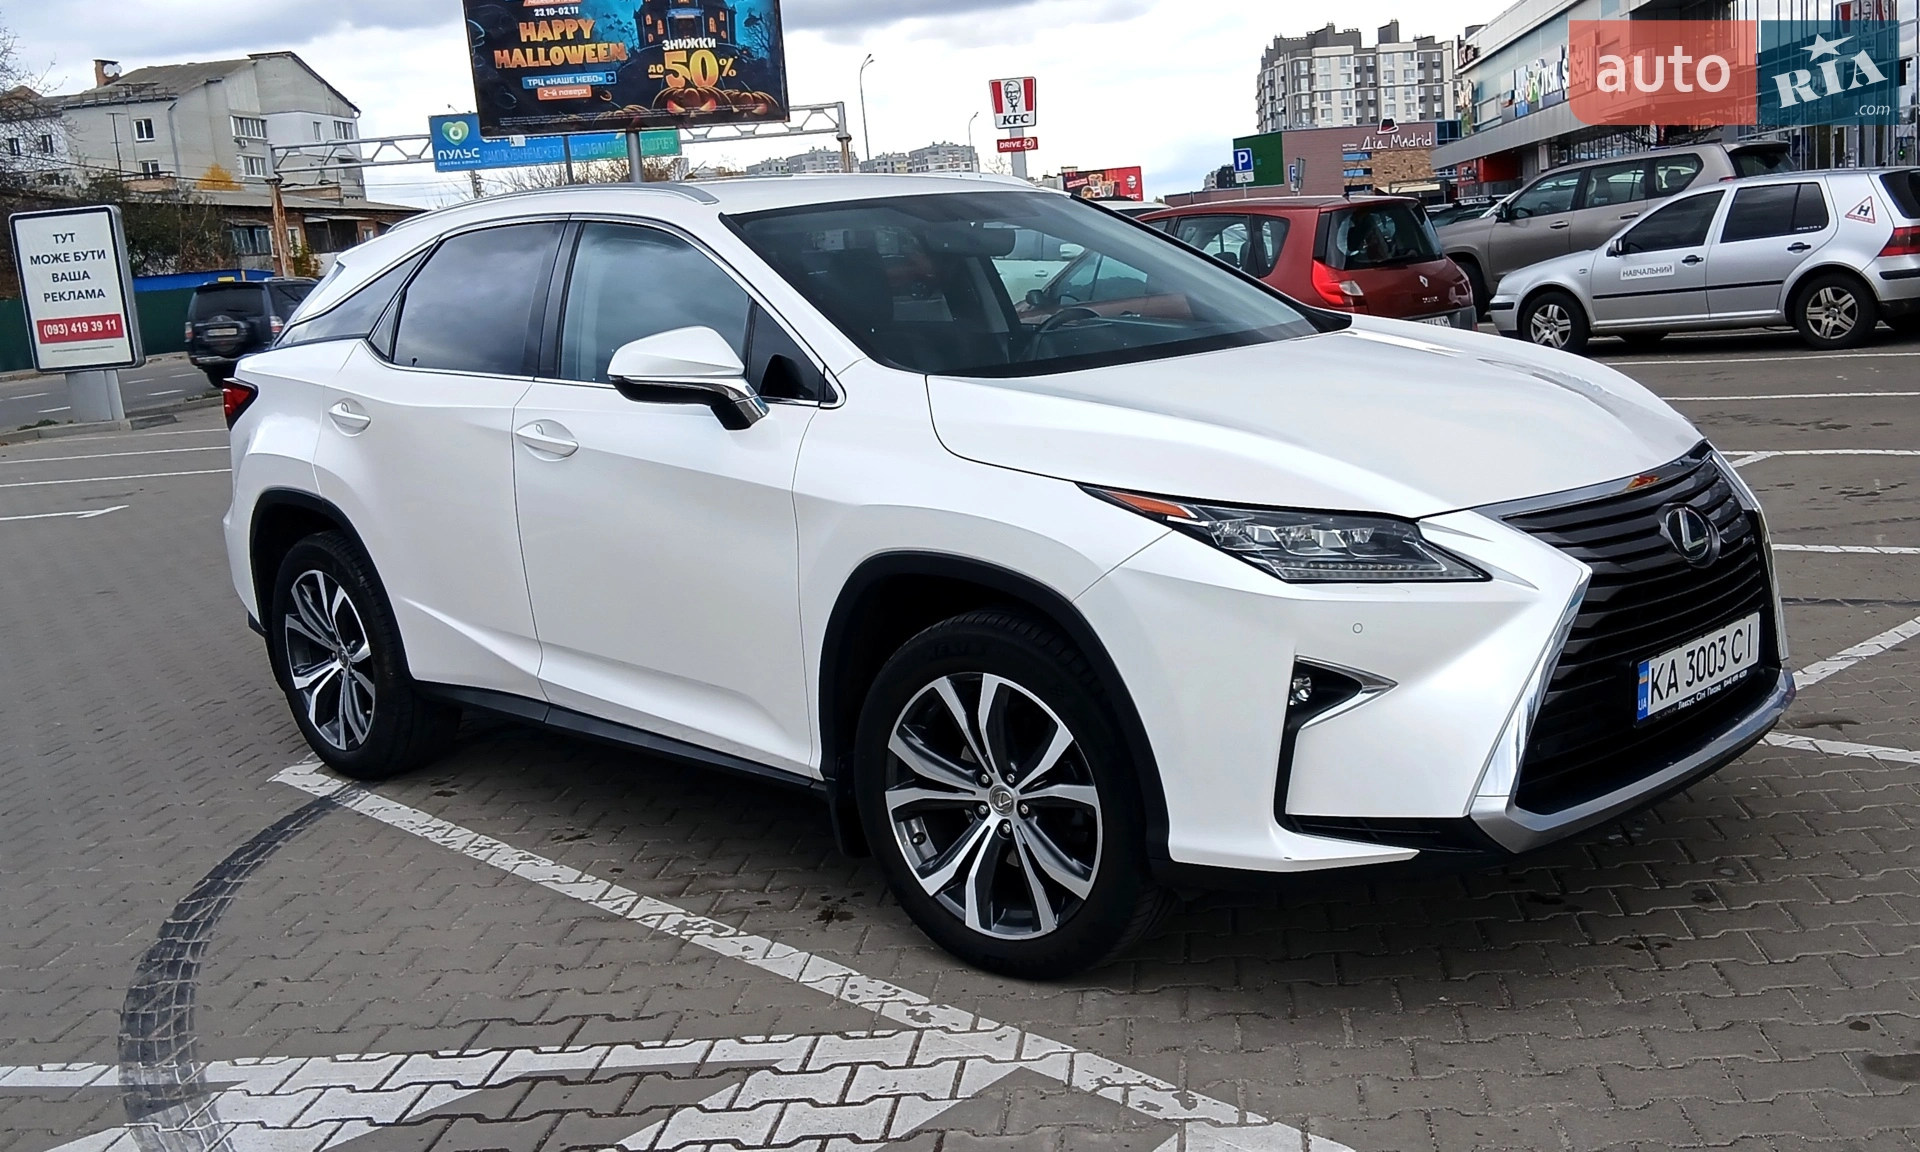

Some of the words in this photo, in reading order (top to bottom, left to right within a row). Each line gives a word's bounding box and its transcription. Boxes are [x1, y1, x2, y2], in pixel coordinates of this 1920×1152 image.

[519, 18, 595, 42] HAPPY
[661, 37, 717, 51] ЗНИЖКИ
[493, 42, 629, 69] HALLOWEEN
[1002, 113, 1029, 125] KFC
[1000, 140, 1022, 149] DRIVE
[1390, 132, 1433, 149] Madrid
[437, 147, 480, 161] ПУЛЬС
[1237, 151, 1249, 170] P
[1857, 205, 1870, 216] Н
[53, 232, 76, 244] ТУТ
[30, 252, 71, 266] МОЖЕ
[73, 249, 106, 262] БУТИ
[51, 270, 91, 283] ВАША
[1622, 264, 1673, 278] НАВЧАЛЬНИЙ
[43, 288, 106, 303] РЕКЛАМА
[43, 323, 69, 338] (093)
[71, 322, 88, 333] 419
[90, 321, 103, 332] 39
[105, 319, 117, 331] 11
[1650, 659, 1680, 705] KA
[1685, 635, 1727, 687] 3003
[1731, 623, 1752, 665] CI
[1637, 698, 1647, 711] UA
